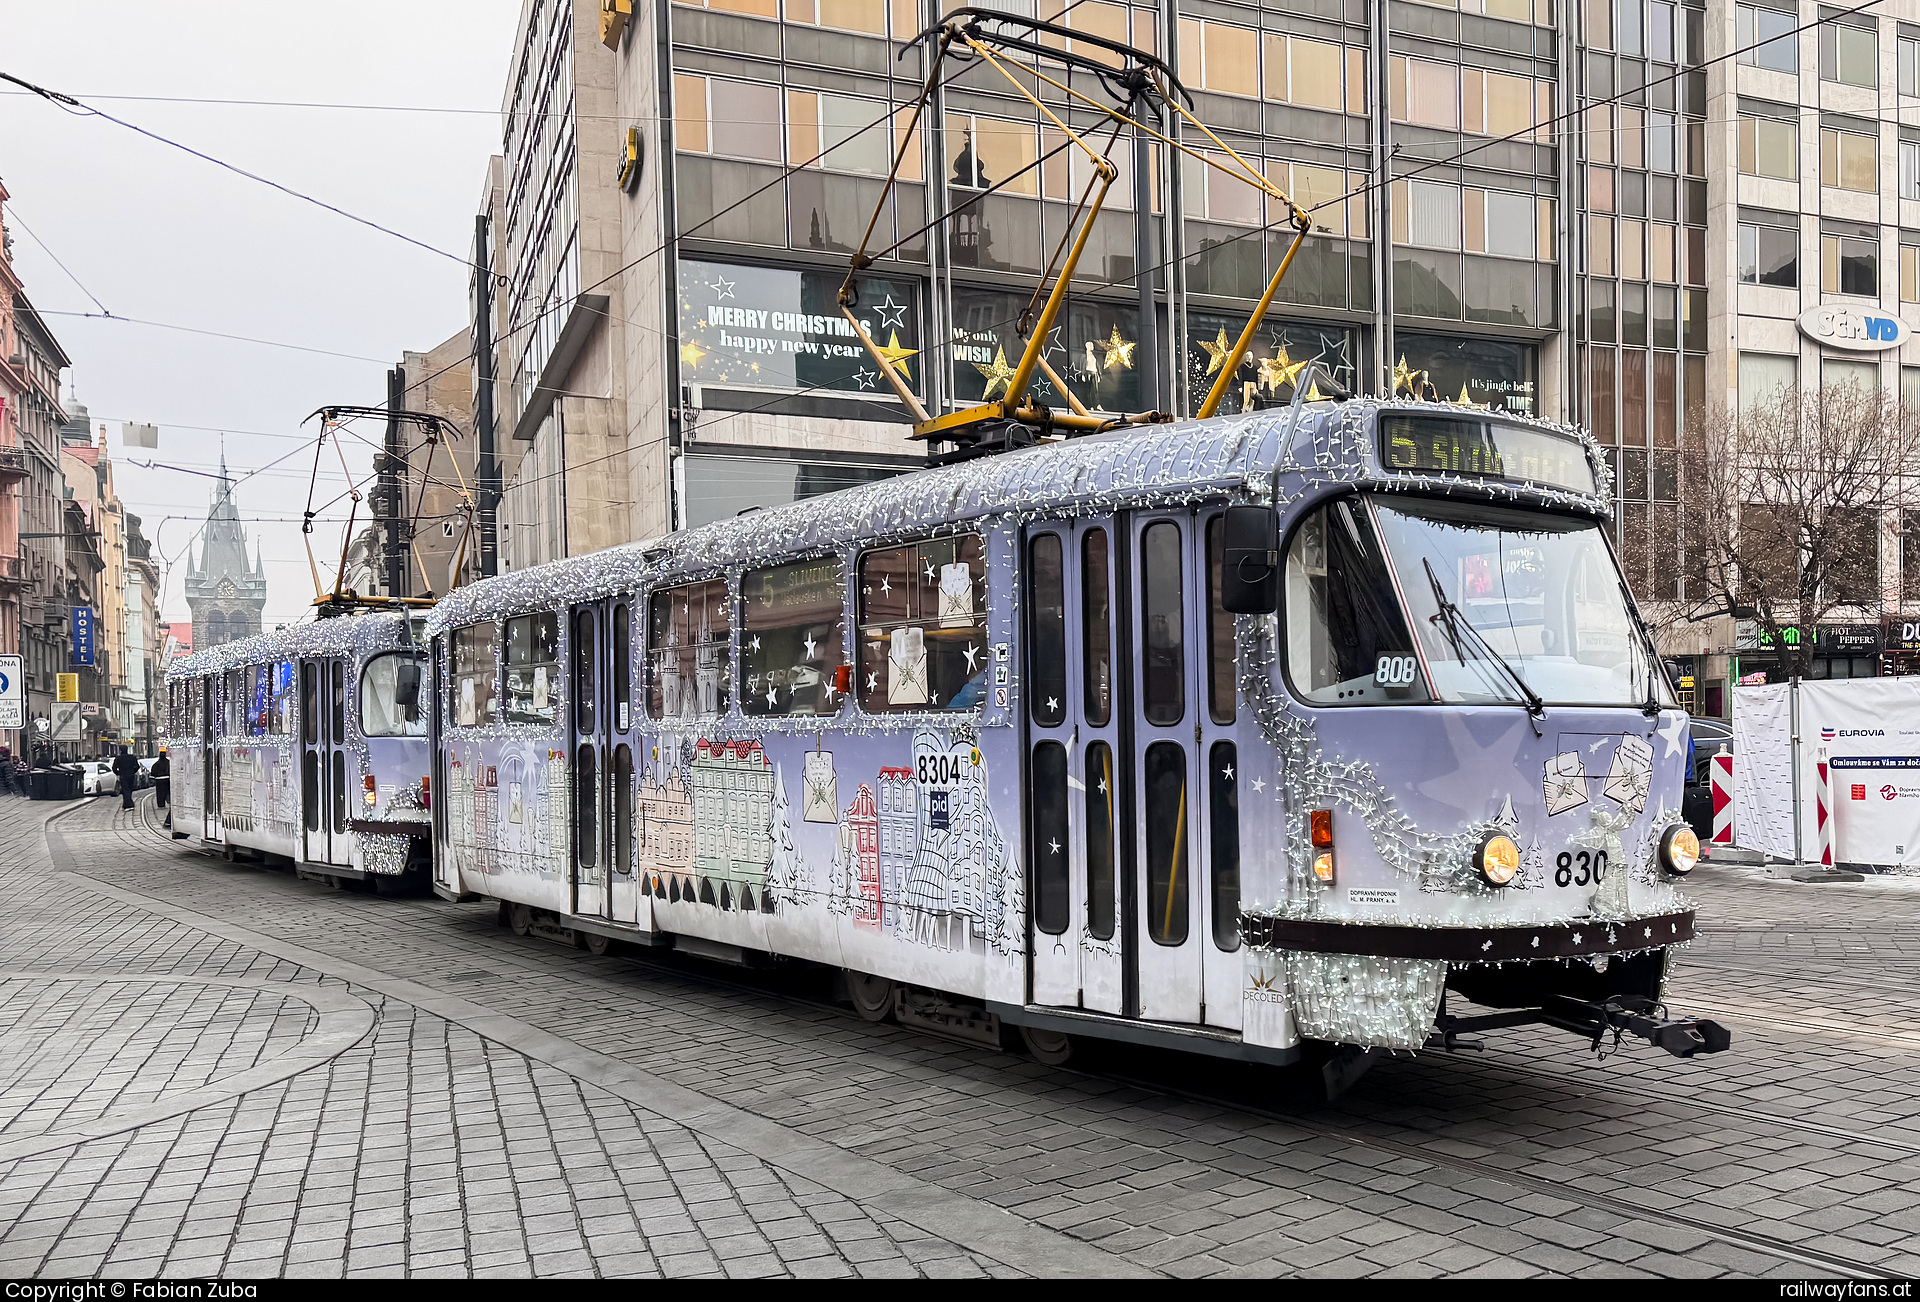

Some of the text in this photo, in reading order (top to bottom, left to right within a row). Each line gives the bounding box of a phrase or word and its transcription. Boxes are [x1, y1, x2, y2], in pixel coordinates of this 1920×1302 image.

[708, 305, 768, 330] MERRY
[1818, 308, 1898, 341] SČMVD
[719, 329, 864, 359] happy new year
[953, 327, 999, 345] My only
[953, 344, 992, 363] WISH
[1471, 378, 1485, 389] It's
[1485, 379, 1512, 393] jingle
[1391, 421, 1417, 468] 5
[763, 573, 774, 608] 5
[78, 610, 88, 662] HOSTEL
[1831, 627, 1851, 637] HOT
[1839, 636, 1875, 644] PEPPERS
[1376, 656, 1416, 683] 808
[1839, 729, 1885, 737] EUROVIA
[918, 755, 961, 785] 8304
[1833, 759, 1871, 767] Omlouváme
[1882, 759, 1897, 767] Vám
[932, 795, 948, 816] pid
[1554, 849, 1609, 888] 830
[1243, 990, 1284, 1004] DECOLED
